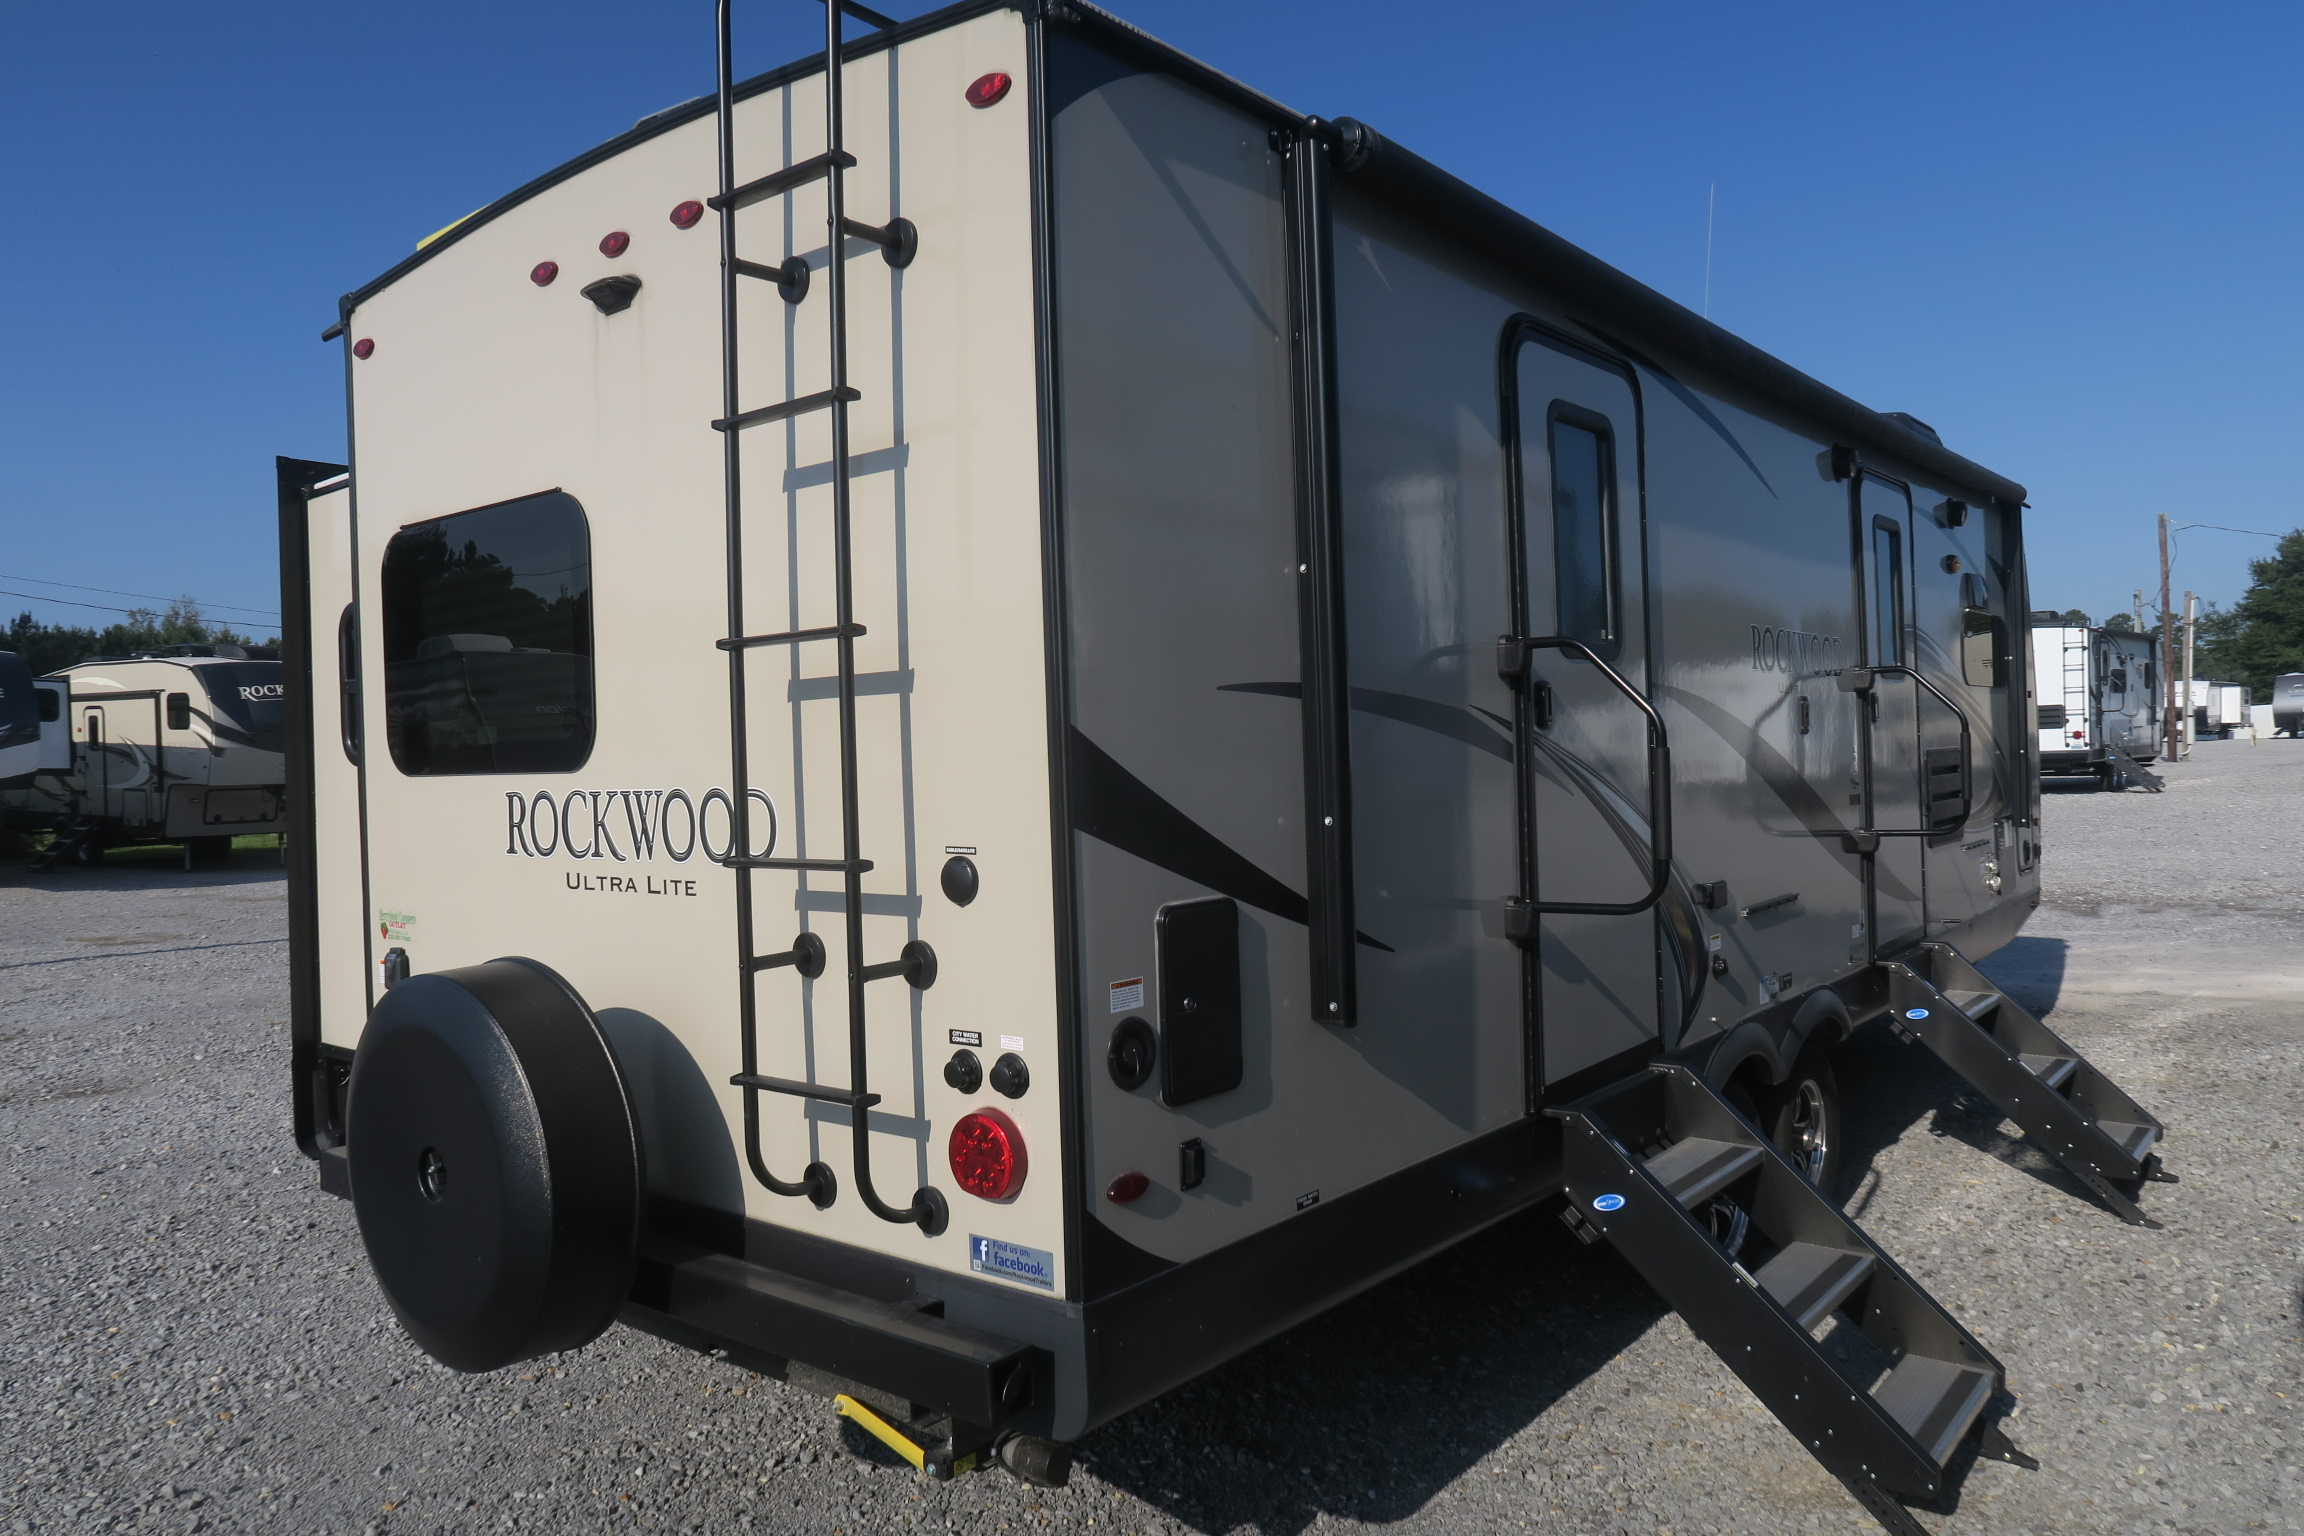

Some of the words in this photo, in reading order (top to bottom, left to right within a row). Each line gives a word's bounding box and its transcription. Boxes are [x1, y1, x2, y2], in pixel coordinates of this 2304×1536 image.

[1750, 623, 1843, 677] ROCKWOOD
[504, 787, 778, 866] ROCKWOOD
[566, 872, 638, 893] ULTRA
[647, 875, 697, 897] LITE
[952, 1036, 980, 1045] CONNECTION
[963, 1031, 979, 1039] WATER
[992, 1241, 1008, 1252] Find
[1009, 1246, 1018, 1255] us
[1019, 1248, 1031, 1258] on:
[993, 1251, 1044, 1277] facebook
